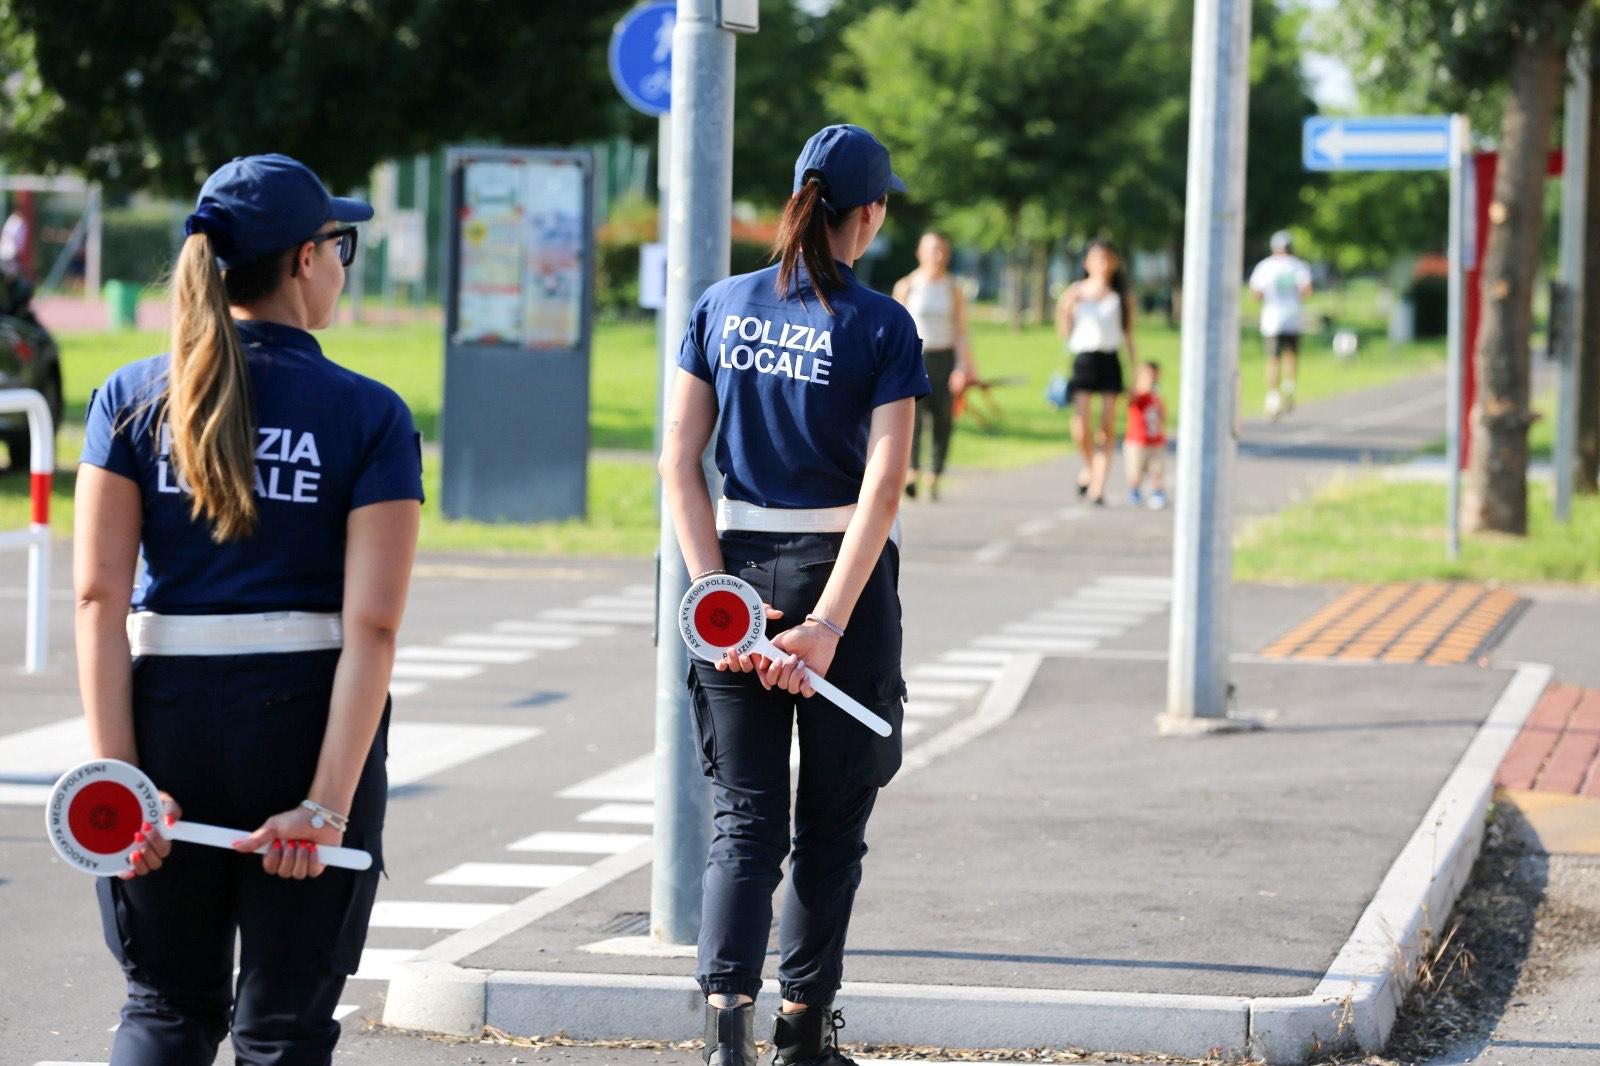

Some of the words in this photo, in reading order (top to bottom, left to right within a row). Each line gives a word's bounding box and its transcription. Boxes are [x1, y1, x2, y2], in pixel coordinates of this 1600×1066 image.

[722, 315, 833, 357] POLIZIA
[720, 343, 832, 385] LOCALE
[687, 585, 705, 605] MEDIO
[705, 578, 744, 590] POLESINE
[751, 604, 762, 640] LOCALE
[52, 793, 64, 826] MEDIO
[62, 764, 107, 793] POLESINE
[135, 780, 159, 825] LOCALE
